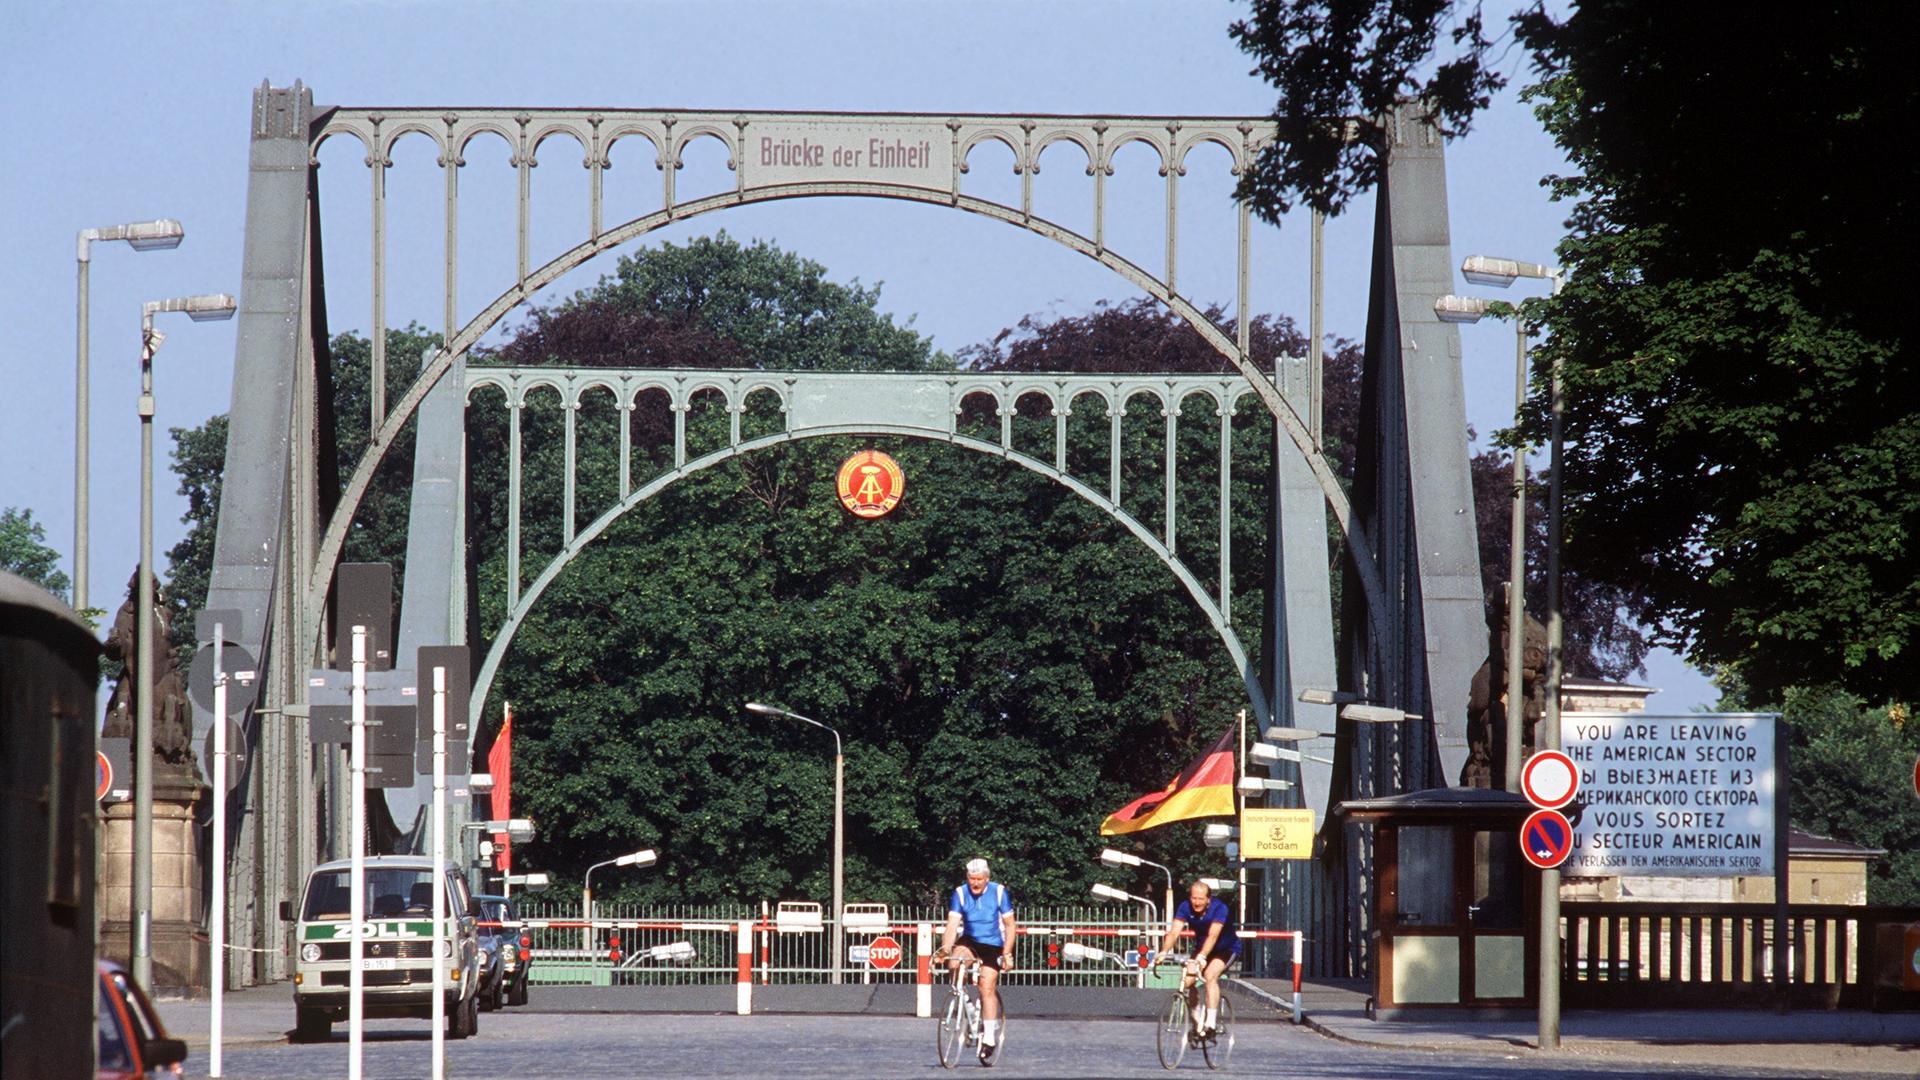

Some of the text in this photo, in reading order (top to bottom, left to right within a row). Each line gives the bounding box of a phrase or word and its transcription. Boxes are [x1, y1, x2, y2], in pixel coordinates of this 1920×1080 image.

[761, 137, 930, 169] Brücke der Einheit
[1577, 725, 1746, 741] YOU ARE LEAVING
[1566, 746, 1757, 762] THE AMERICAN SECTOR
[1582, 769, 1754, 785] Ы ВЫЕЗЖАЕТЕ ИЗ
[1575, 790, 1759, 806] МЕРИКАНСКОГО СЕКТОРА
[1595, 812, 1726, 829] VOUS SORTEZ
[1257, 841, 1298, 850] Potsdam
[1573, 833, 1761, 850] U SECTEUR AMERICAIN
[1579, 855, 1627, 867] VERLASSEN
[1631, 855, 1649, 867] DEN
[1652, 855, 1725, 868] AMERIKANISCHEN
[1729, 856, 1761, 868] SEKTOR
[333, 922, 418, 938] ZOLL
[870, 947, 899, 960] STOP
